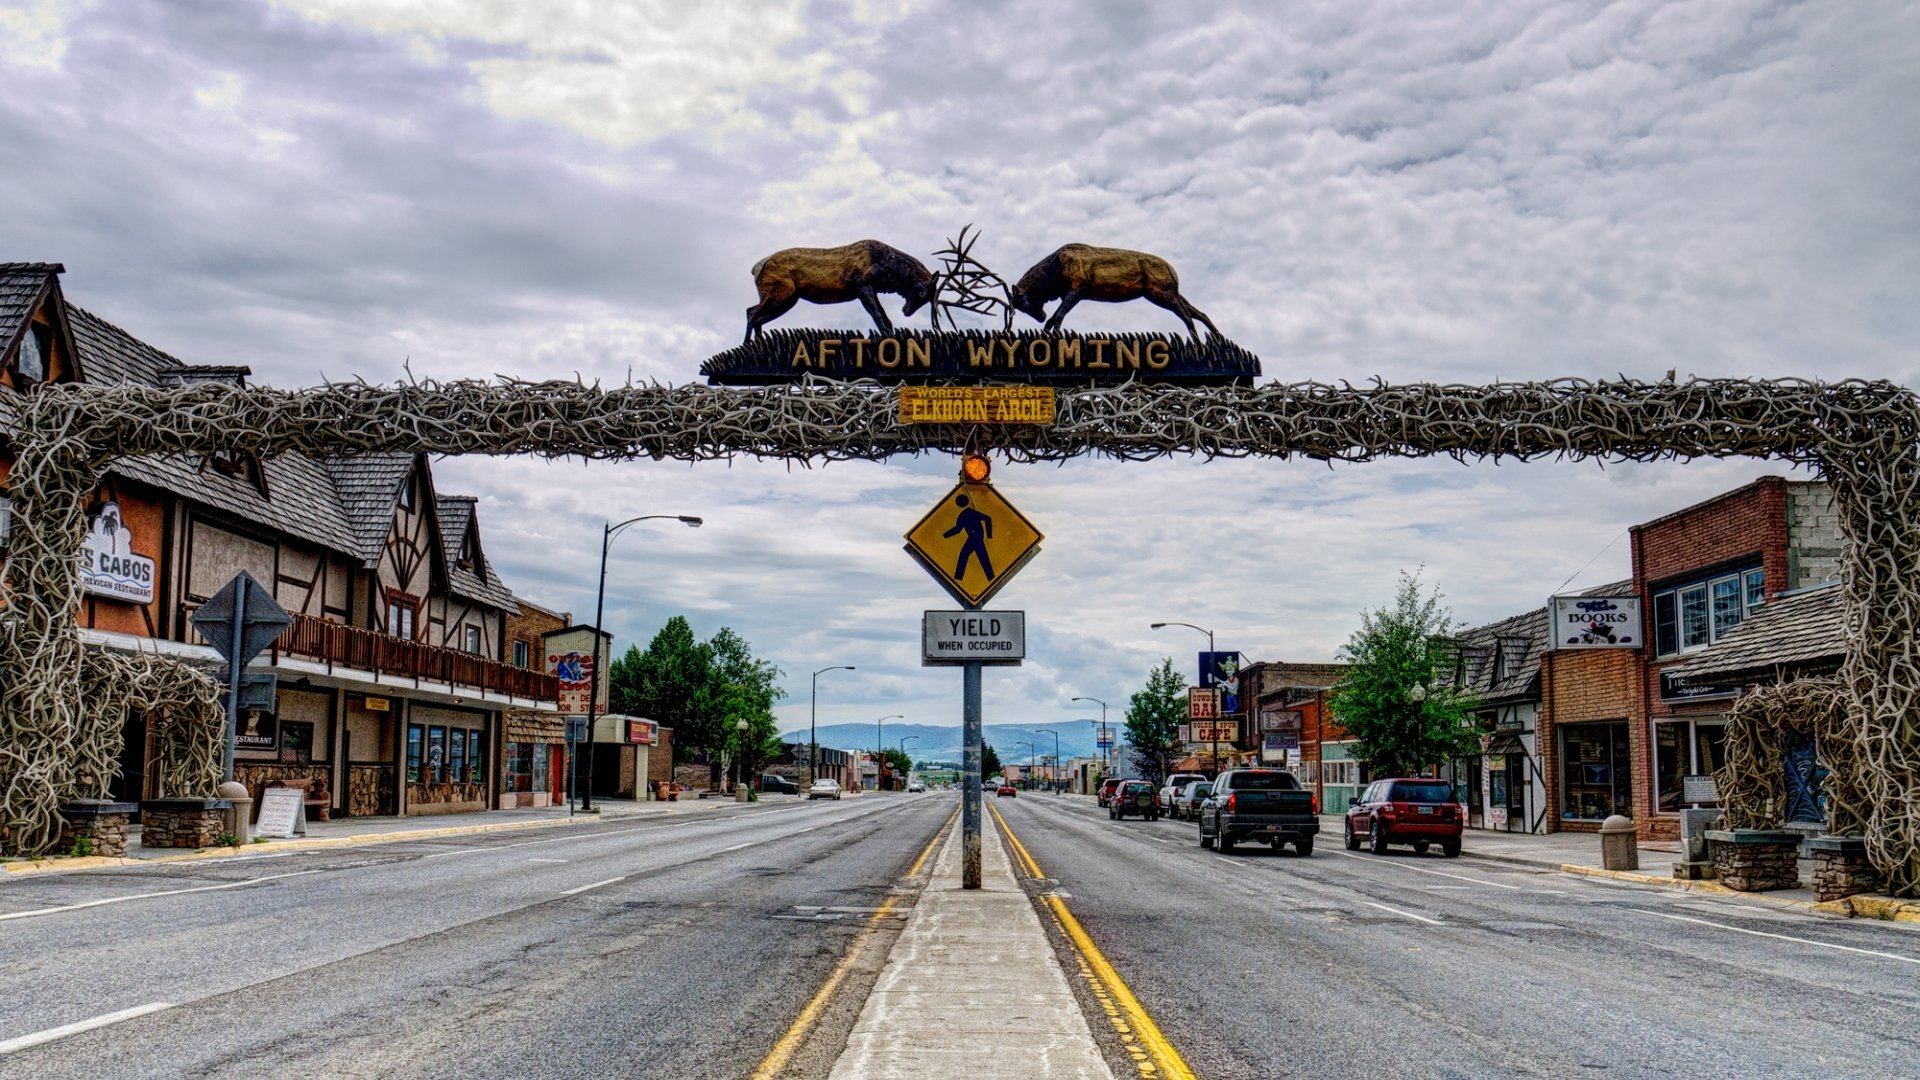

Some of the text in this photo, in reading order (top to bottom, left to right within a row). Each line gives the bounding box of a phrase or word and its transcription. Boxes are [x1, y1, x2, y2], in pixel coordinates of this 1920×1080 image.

[791, 339, 1170, 368] AFTON WYOMING
[916, 388, 1041, 398] WORLD'S LARGEST
[912, 399, 1043, 421] ELKHORN ARCH
[100, 552, 150, 582] CABOS
[84, 576, 151, 597] MEXICAN RESTAURANT
[1568, 613, 1628, 623] BOOKS
[949, 618, 1001, 637] YIELD
[937, 641, 1012, 651] WHEN OCCUPIED
[580, 704, 604, 712] STRE
[1199, 729, 1231, 740] CAFE
